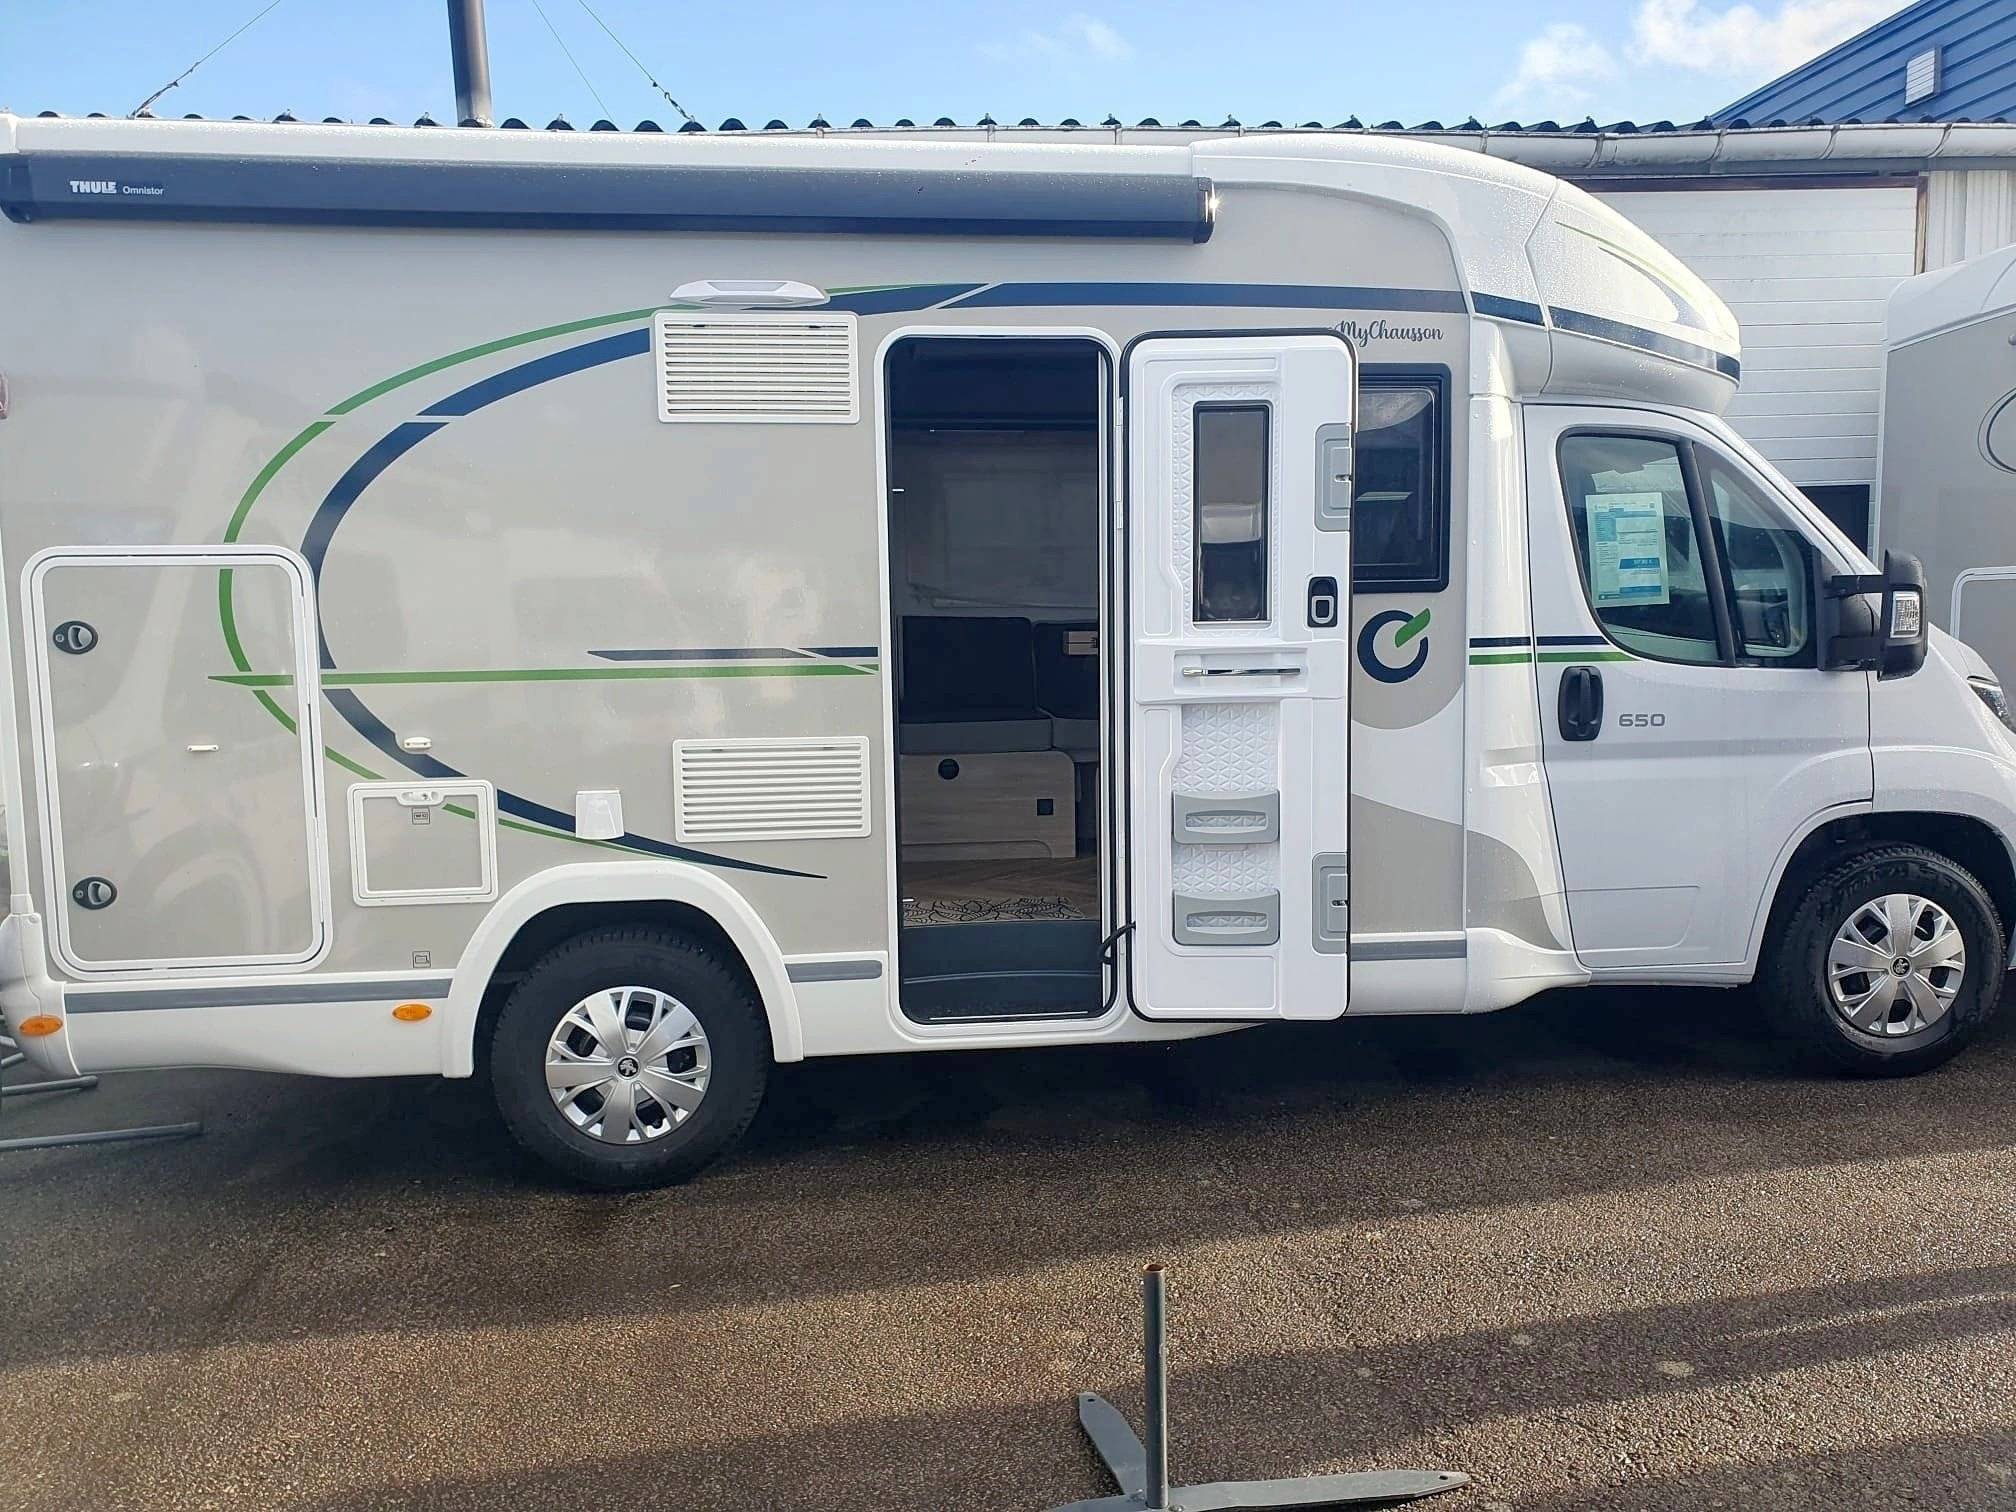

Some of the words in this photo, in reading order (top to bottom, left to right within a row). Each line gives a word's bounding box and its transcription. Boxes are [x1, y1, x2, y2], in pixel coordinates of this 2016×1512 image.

[69, 180, 117, 194] THULE
[122, 185, 165, 195] Omnistor
[1335, 319, 1444, 347] MyChausson
[1618, 713, 1666, 727] 650
